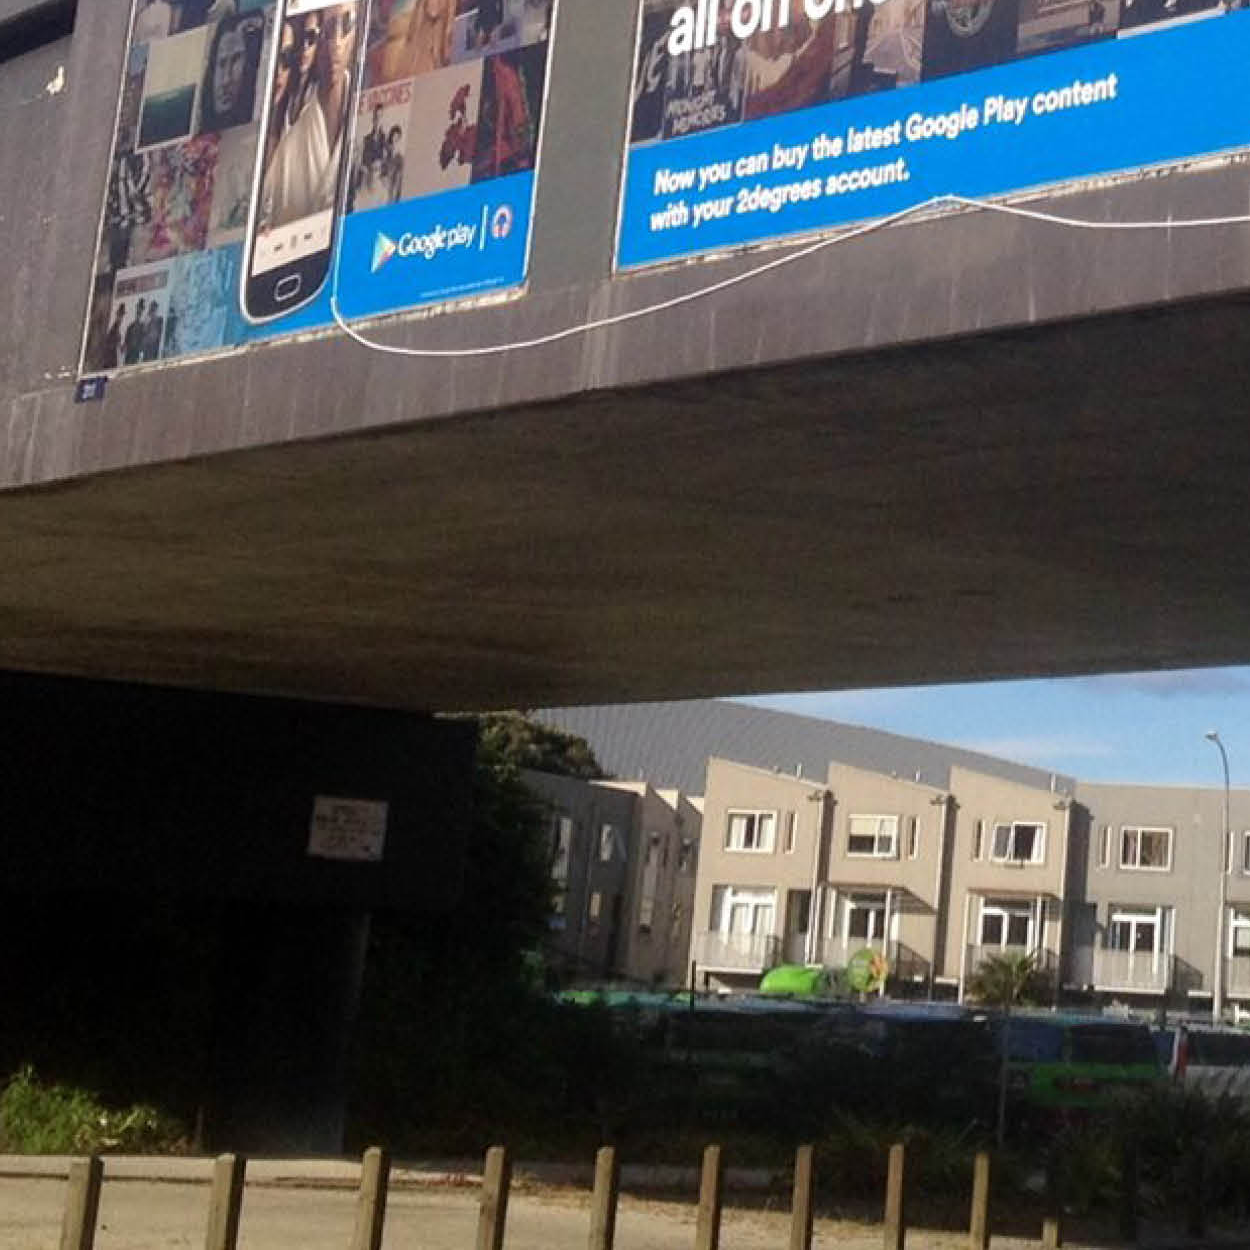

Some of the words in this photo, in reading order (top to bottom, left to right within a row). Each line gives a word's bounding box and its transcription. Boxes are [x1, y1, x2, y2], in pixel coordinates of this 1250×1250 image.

[653, 168, 696, 196] Now
[699, 161, 732, 191] you
[735, 151, 769, 177] can
[772, 143, 809, 170] buy
[812, 132, 842, 161] the
[846, 119, 902, 153] latest
[905, 102, 979, 142] Google
[983, 94, 1029, 126] Play
[1032, 72, 1119, 116] content
[650, 199, 689, 231] with
[693, 195, 735, 228] your
[735, 177, 823, 213] 2degrees
[825, 156, 911, 196] account.
[398, 224, 447, 261] Google
[446, 221, 477, 251] play
